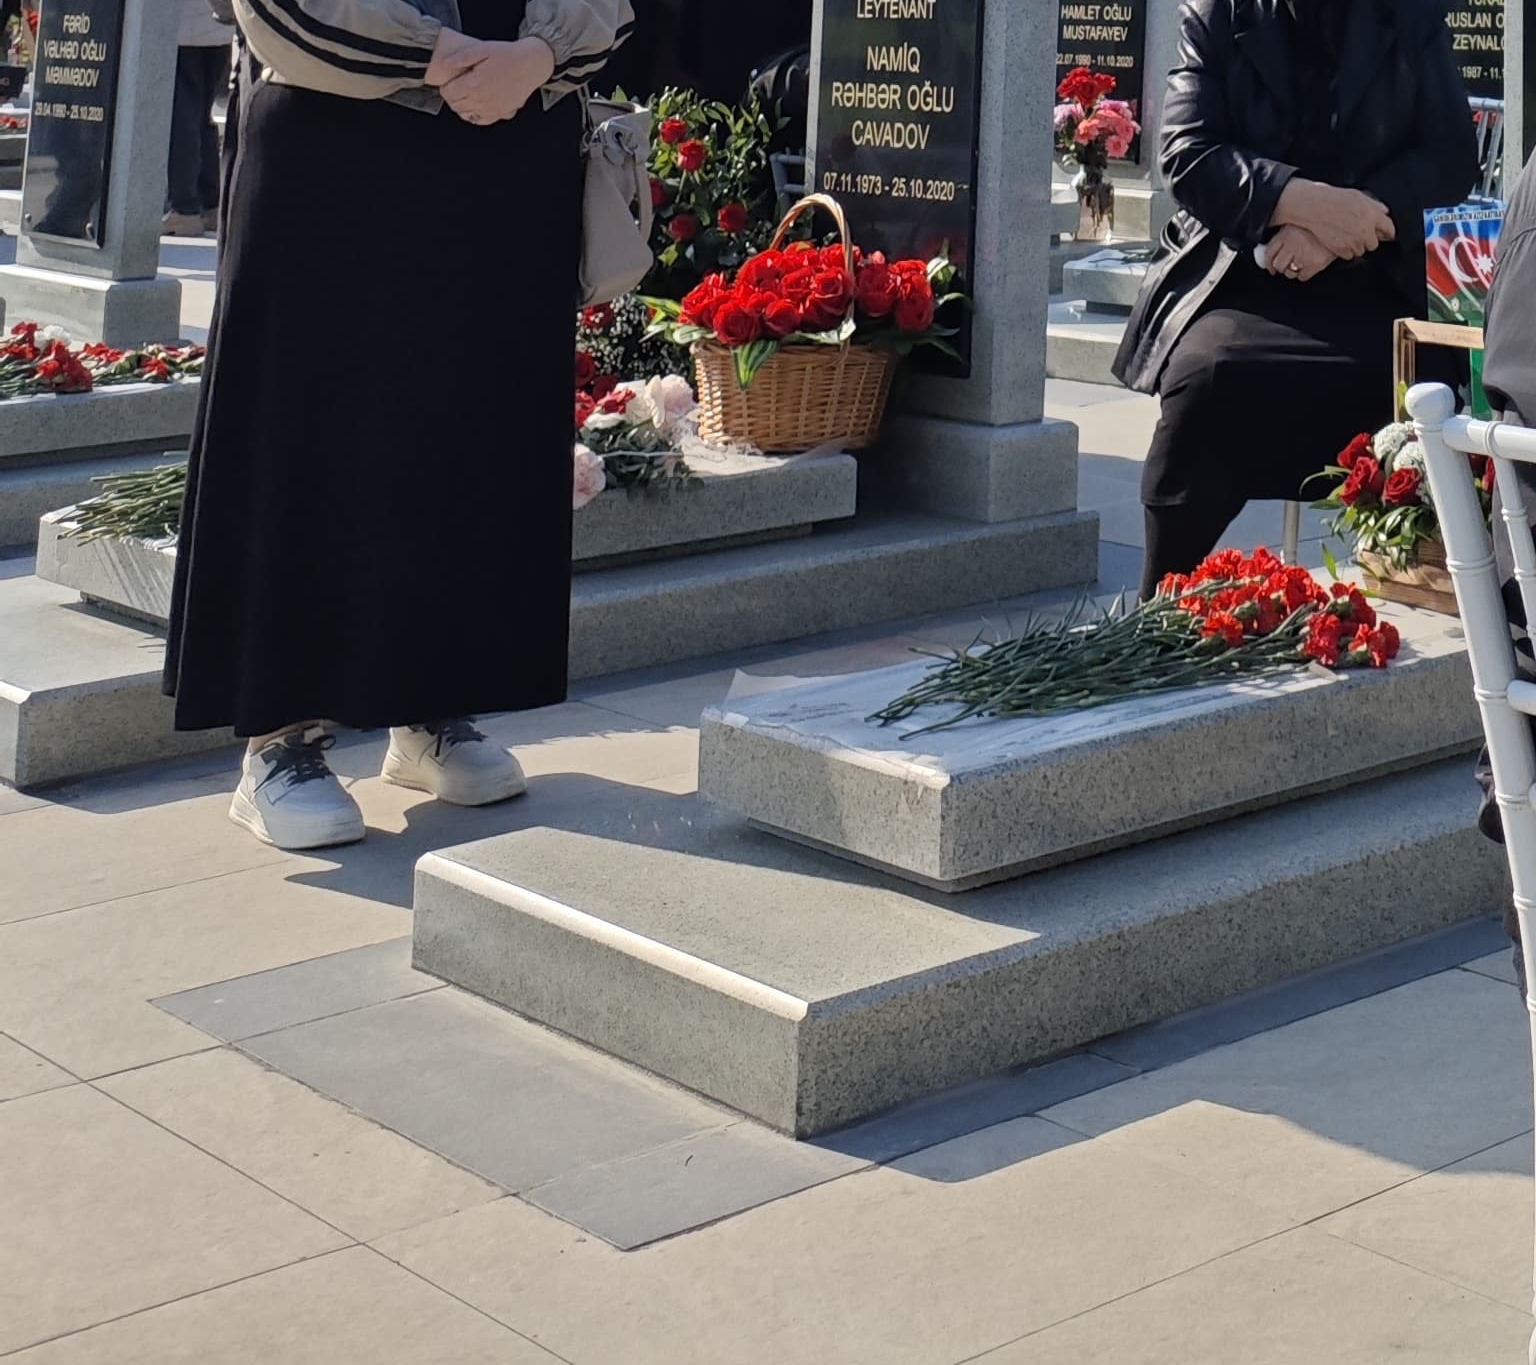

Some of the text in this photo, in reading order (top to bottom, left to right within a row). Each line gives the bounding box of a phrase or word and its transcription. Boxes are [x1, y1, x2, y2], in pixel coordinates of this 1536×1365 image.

[63, 13, 90, 34] FƏRİD
[1061, 4, 1132, 21] HAMLET OĞLU
[1063, 25, 1128, 41] MUSTAFAYEV
[81, 39, 107, 61] OĞLU
[866, 42, 920, 73] NAMİQ
[831, 80, 955, 112] RƏHBƏR OĞLU
[852, 120, 930, 149] CAVADOV
[823, 172, 882, 195] 07.11.1973
[892, 177, 955, 201] 25.10.2020
